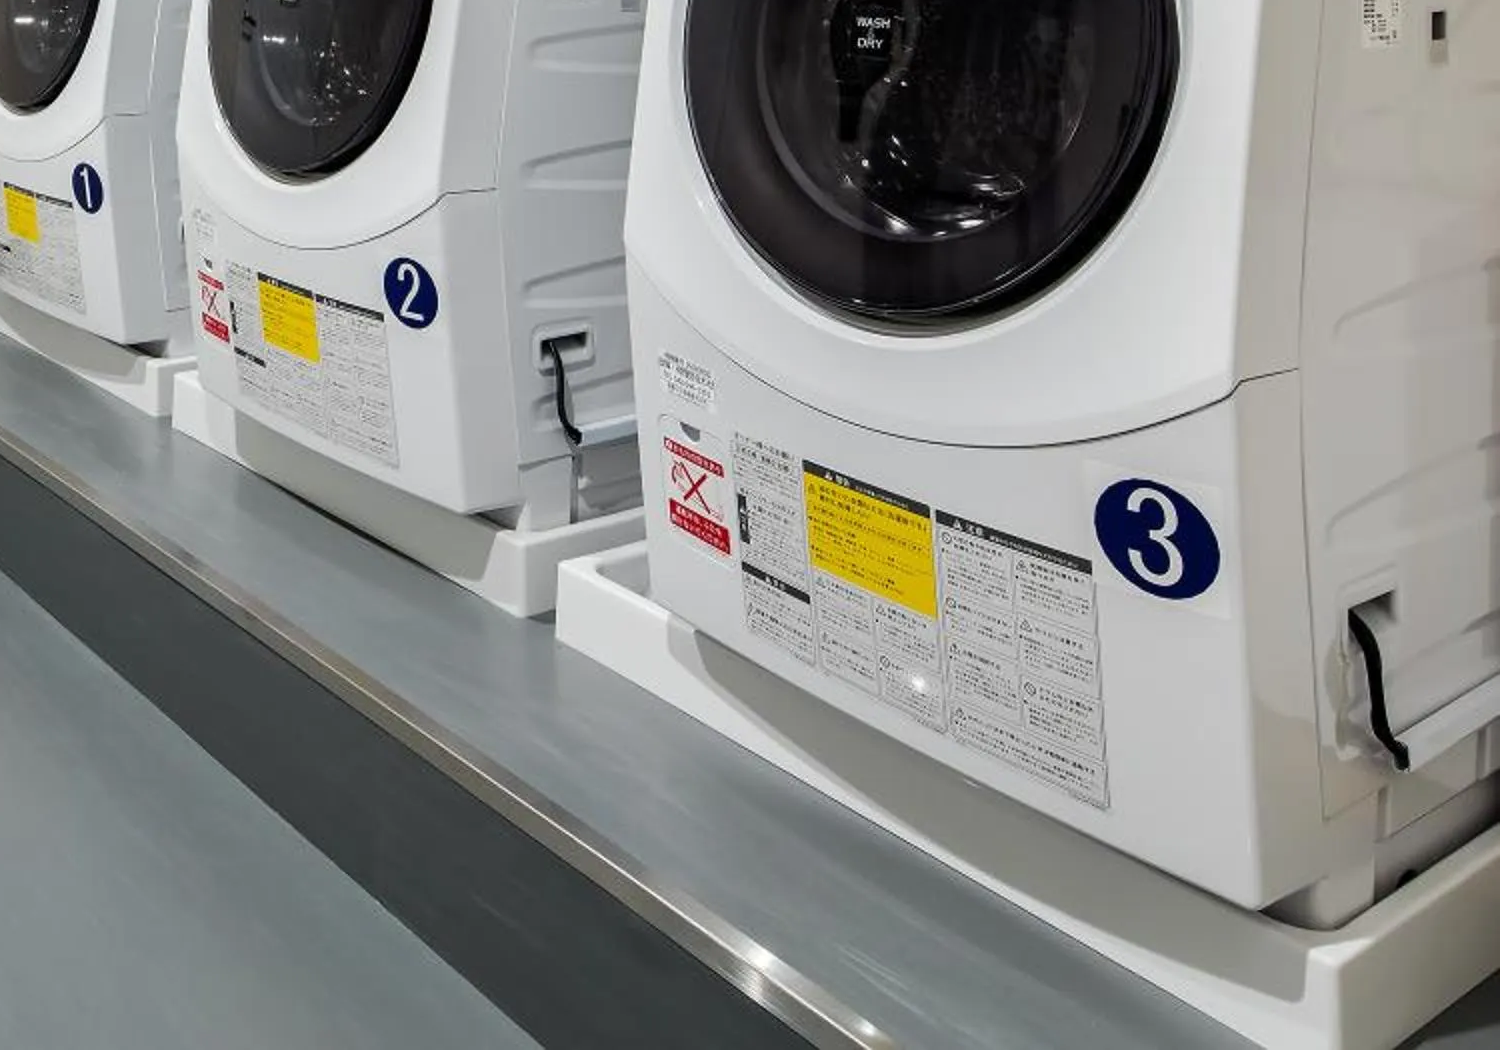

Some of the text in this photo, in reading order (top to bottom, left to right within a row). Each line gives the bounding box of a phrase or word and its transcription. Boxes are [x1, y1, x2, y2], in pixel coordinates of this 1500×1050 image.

[856, 17, 891, 29] WASH
[857, 37, 884, 49] DRY
[79, 166, 94, 210] 1
[397, 262, 425, 322] 2
[1126, 486, 1184, 588] 3
